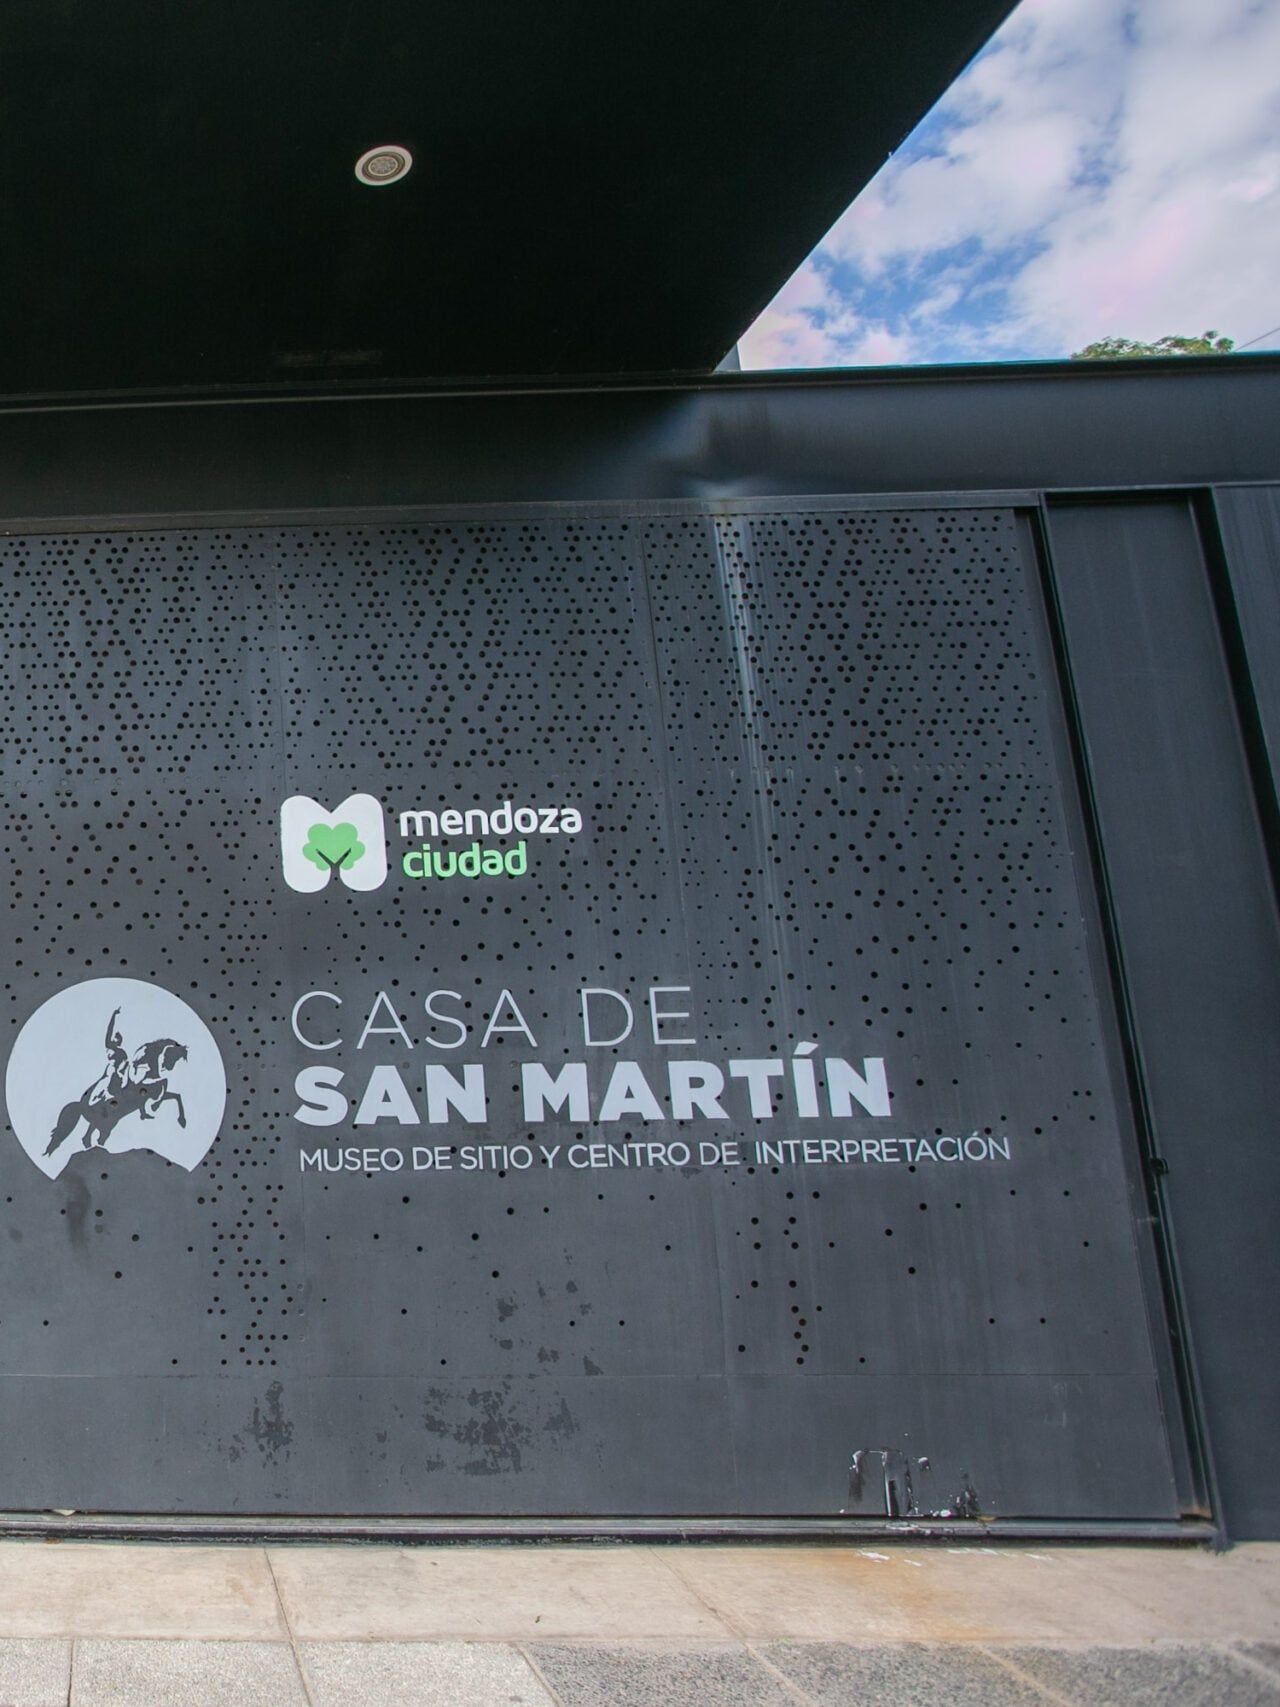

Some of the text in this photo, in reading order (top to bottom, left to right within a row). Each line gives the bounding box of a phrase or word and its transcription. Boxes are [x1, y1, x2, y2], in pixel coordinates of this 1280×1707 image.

[399, 801, 583, 837] mendoza
[402, 842, 527, 878] ciudad
[291, 986, 697, 1051] CASA DE
[293, 1042, 892, 1127] SAN MARTÍN
[299, 1131, 1011, 1172] MUSEO DE SITIO Y CENTRO DE INTERPRETACIÓN
